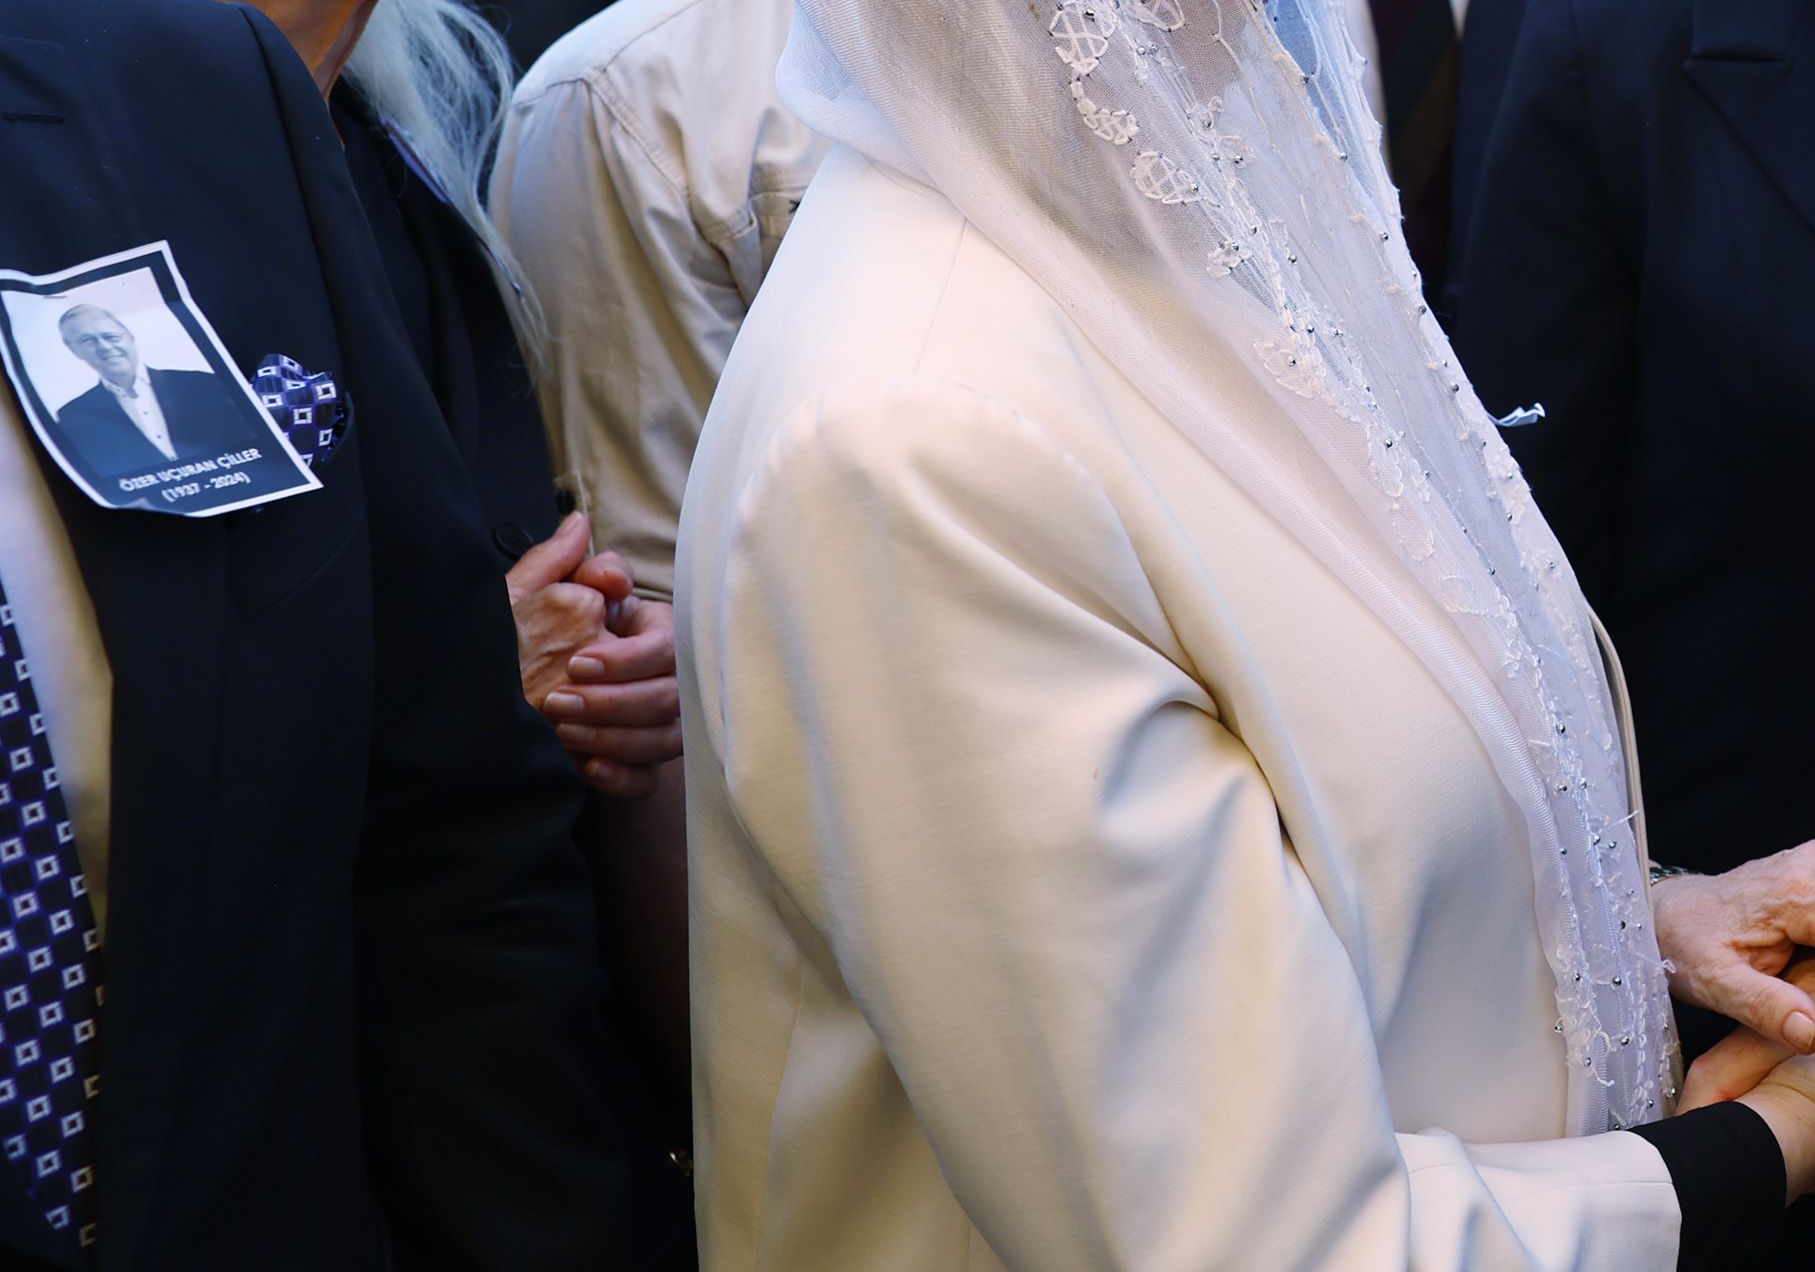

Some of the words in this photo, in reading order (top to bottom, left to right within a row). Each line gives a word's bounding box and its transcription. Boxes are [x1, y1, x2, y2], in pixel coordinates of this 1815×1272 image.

[118, 475, 160, 492] ÖZER
[156, 460, 218, 481] UÇURAN
[217, 447, 263, 468] ÇİLLER
[161, 482, 200, 503] (1937
[209, 471, 251, 489] 2024)
